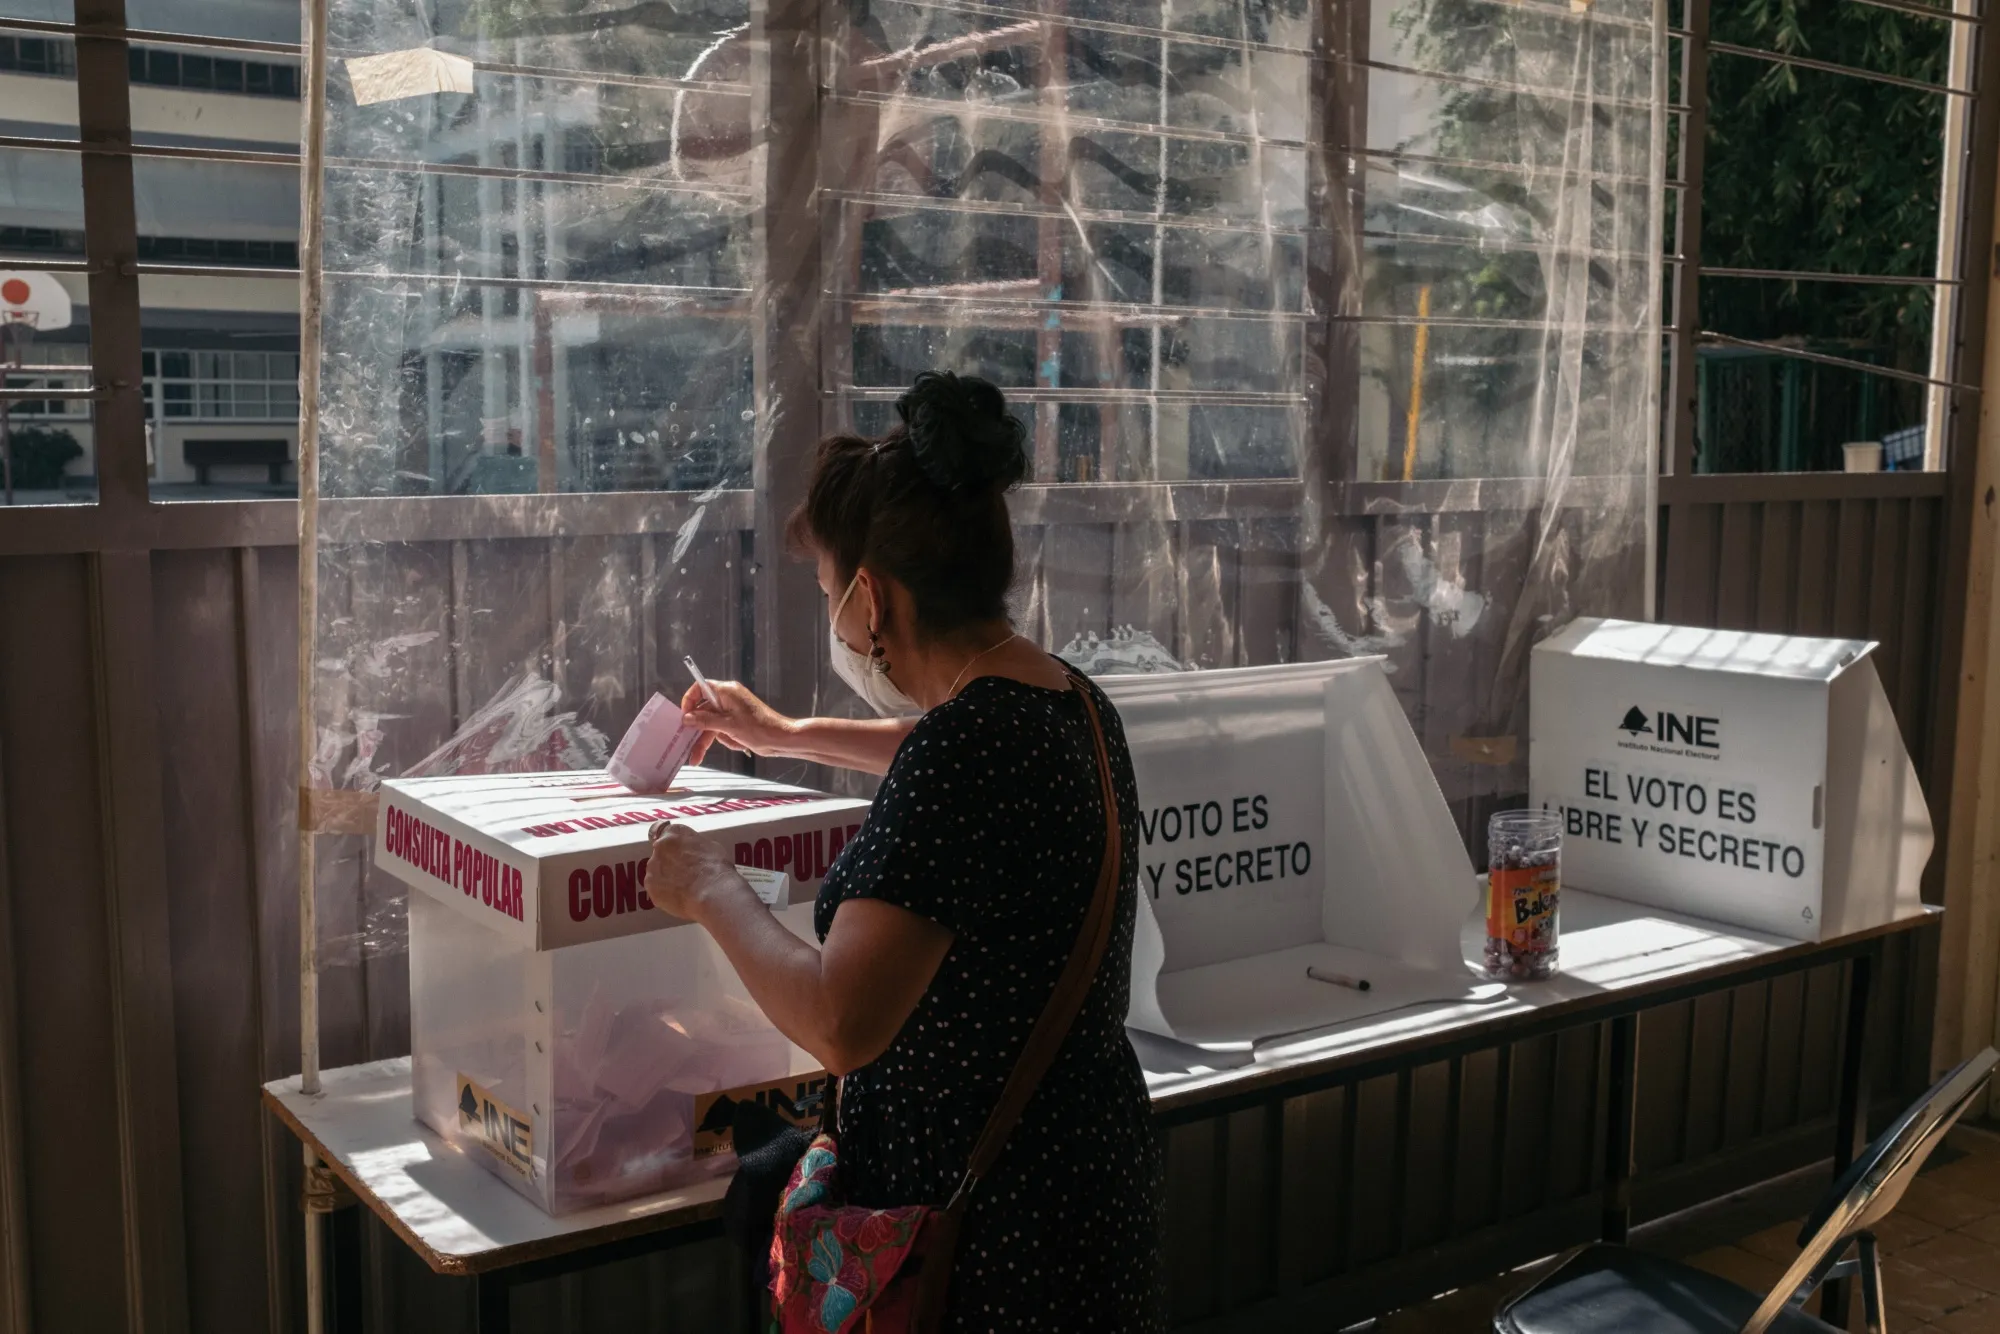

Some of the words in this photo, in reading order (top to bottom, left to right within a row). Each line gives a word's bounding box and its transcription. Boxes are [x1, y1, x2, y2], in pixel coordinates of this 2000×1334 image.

[1650, 744, 1684, 756] Nacional
[1685, 749, 1720, 761] Electoral
[1657, 711, 1720, 749] INE
[521, 808, 681, 838] POPULAR
[1139, 801, 1223, 846] VOTO
[1233, 794, 1269, 833] ES
[1585, 767, 1618, 801] EL
[1626, 774, 1707, 815] VOTO
[1717, 787, 1757, 824] ES
[386, 804, 451, 885] CONSULTA
[453, 838, 524, 922] POPULAR
[1146, 862, 1166, 900] Y
[1175, 841, 1312, 896] SECRETO
[1631, 817, 1649, 848] Y
[1657, 823, 1806, 878] SECRETO
[483, 1098, 531, 1166] INE
